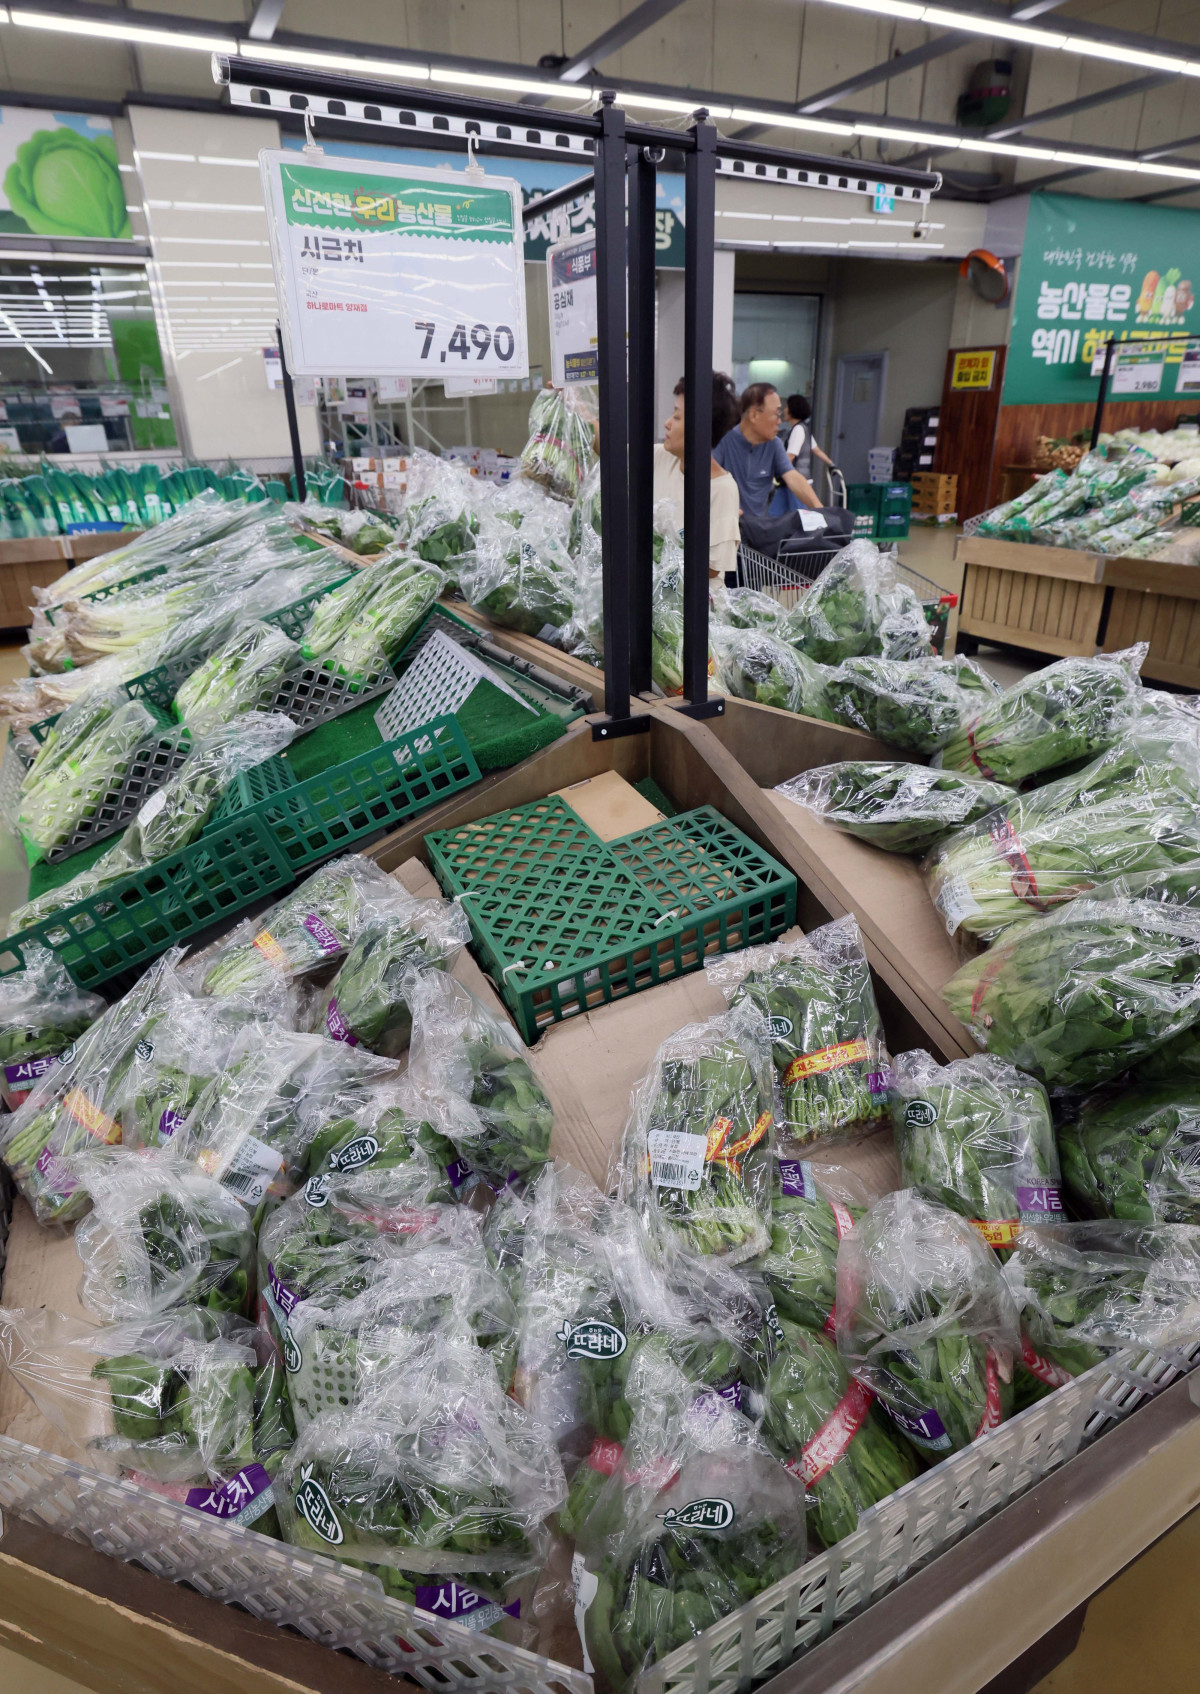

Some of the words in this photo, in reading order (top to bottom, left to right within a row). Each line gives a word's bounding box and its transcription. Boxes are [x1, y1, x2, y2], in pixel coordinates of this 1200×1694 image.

[292, 188, 351, 217] 신선한
[355, 195, 395, 222] 우리
[398, 200, 452, 225] 농산물
[301, 236, 364, 262] 시금치
[306, 301, 344, 311] 하나로마트
[345, 303, 368, 313] 양재점
[553, 289, 574, 311] 공심채
[1037, 281, 1131, 321] 농산물은
[415, 321, 515, 363] 7,490
[1031, 328, 1080, 365] 역시
[972, 370, 987, 382] 금지
[16, 1058, 56, 1077] 시금
[1027, 1177, 1050, 1186] KOREA
[1030, 1190, 1062, 1210] 시금
